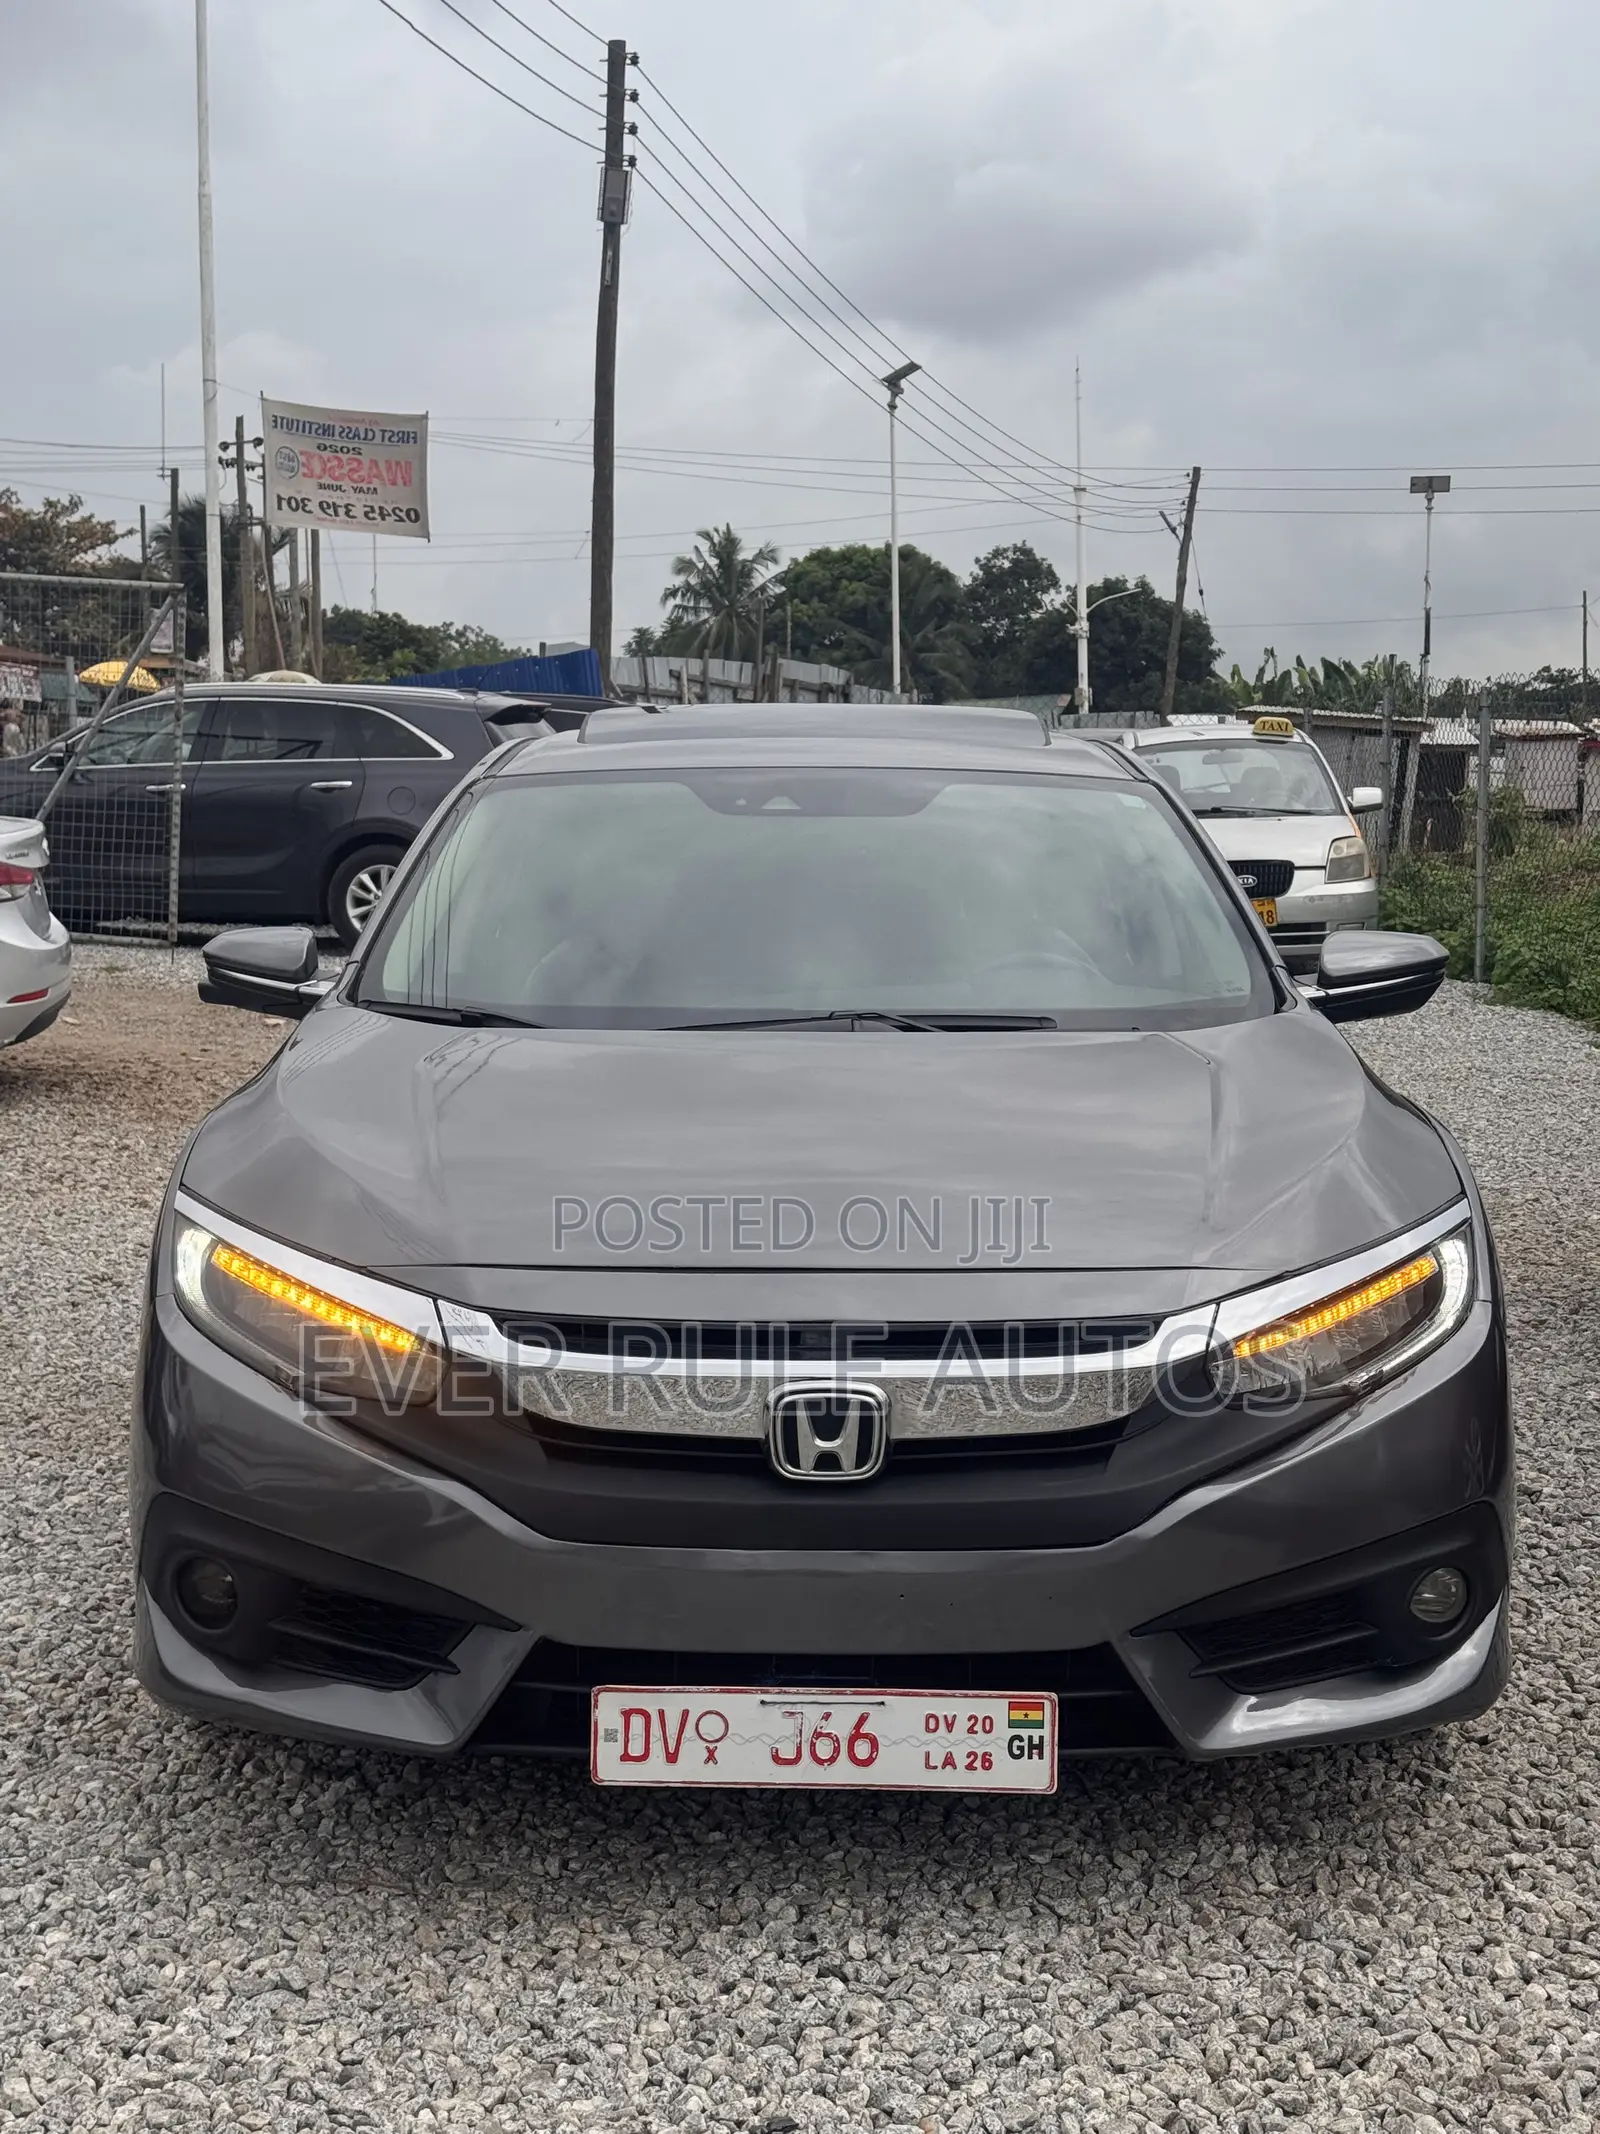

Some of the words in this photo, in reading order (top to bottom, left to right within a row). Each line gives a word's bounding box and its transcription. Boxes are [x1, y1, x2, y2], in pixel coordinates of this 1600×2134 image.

[1260, 720, 1289, 731] TAXI
[924, 1713, 957, 1734] DV
[967, 1714, 994, 1735] 20
[620, 1708, 690, 1764] DV
[770, 1711, 880, 1767] J66
[1007, 1734, 1045, 1760] GH
[924, 1750, 957, 1770] LA
[965, 1751, 994, 1771] 26
